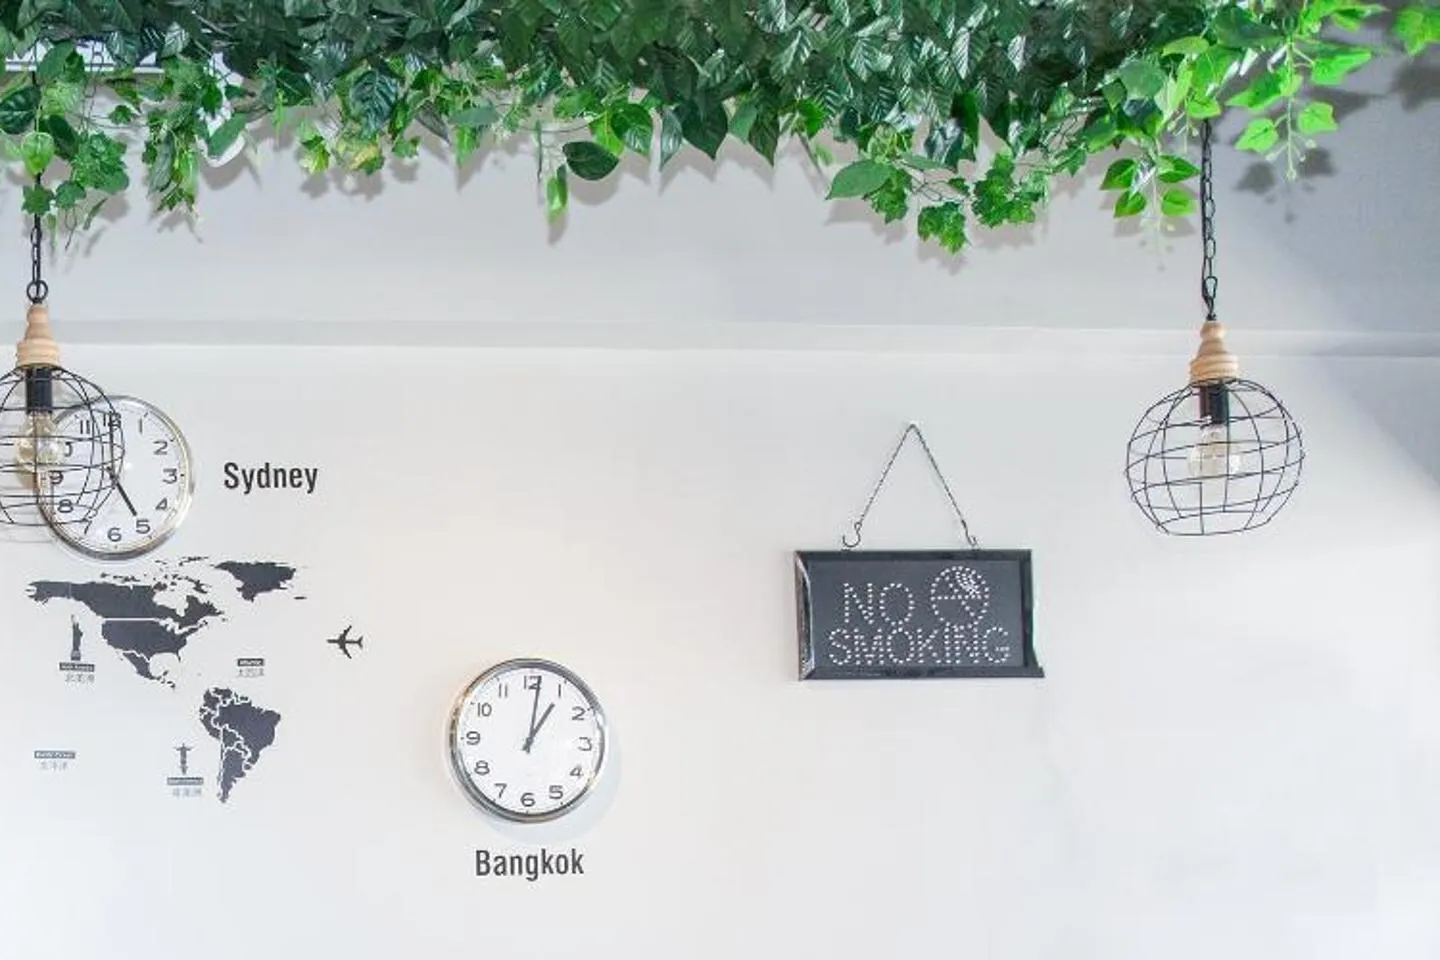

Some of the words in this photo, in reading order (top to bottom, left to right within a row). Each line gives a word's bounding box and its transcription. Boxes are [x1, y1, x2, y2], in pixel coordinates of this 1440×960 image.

[81, 420, 90, 434] 11
[138, 418, 143, 433] 1
[153, 440, 168, 455] 2
[163, 468, 177, 484] 3
[224, 461, 319, 495] Sydney
[57, 499, 74, 513] 8
[156, 498, 168, 511] 4
[136, 519, 151, 534] 5
[108, 528, 122, 542] 6
[843, 582, 914, 625] NO
[829, 627, 1010, 666] SMOKING
[524, 676, 542, 690] 12
[499, 683, 508, 699] 11
[558, 684, 562, 699] 1
[477, 702, 492, 717] 10
[571, 706, 586, 721] 2
[466, 731, 481, 746] 9
[578, 737, 593, 752] 3
[474, 760, 490, 775] 8
[569, 766, 583, 779] 4
[495, 783, 507, 799] 7
[549, 785, 564, 800] 5
[520, 793, 536, 807] 6
[476, 848, 585, 882] Bangkok
